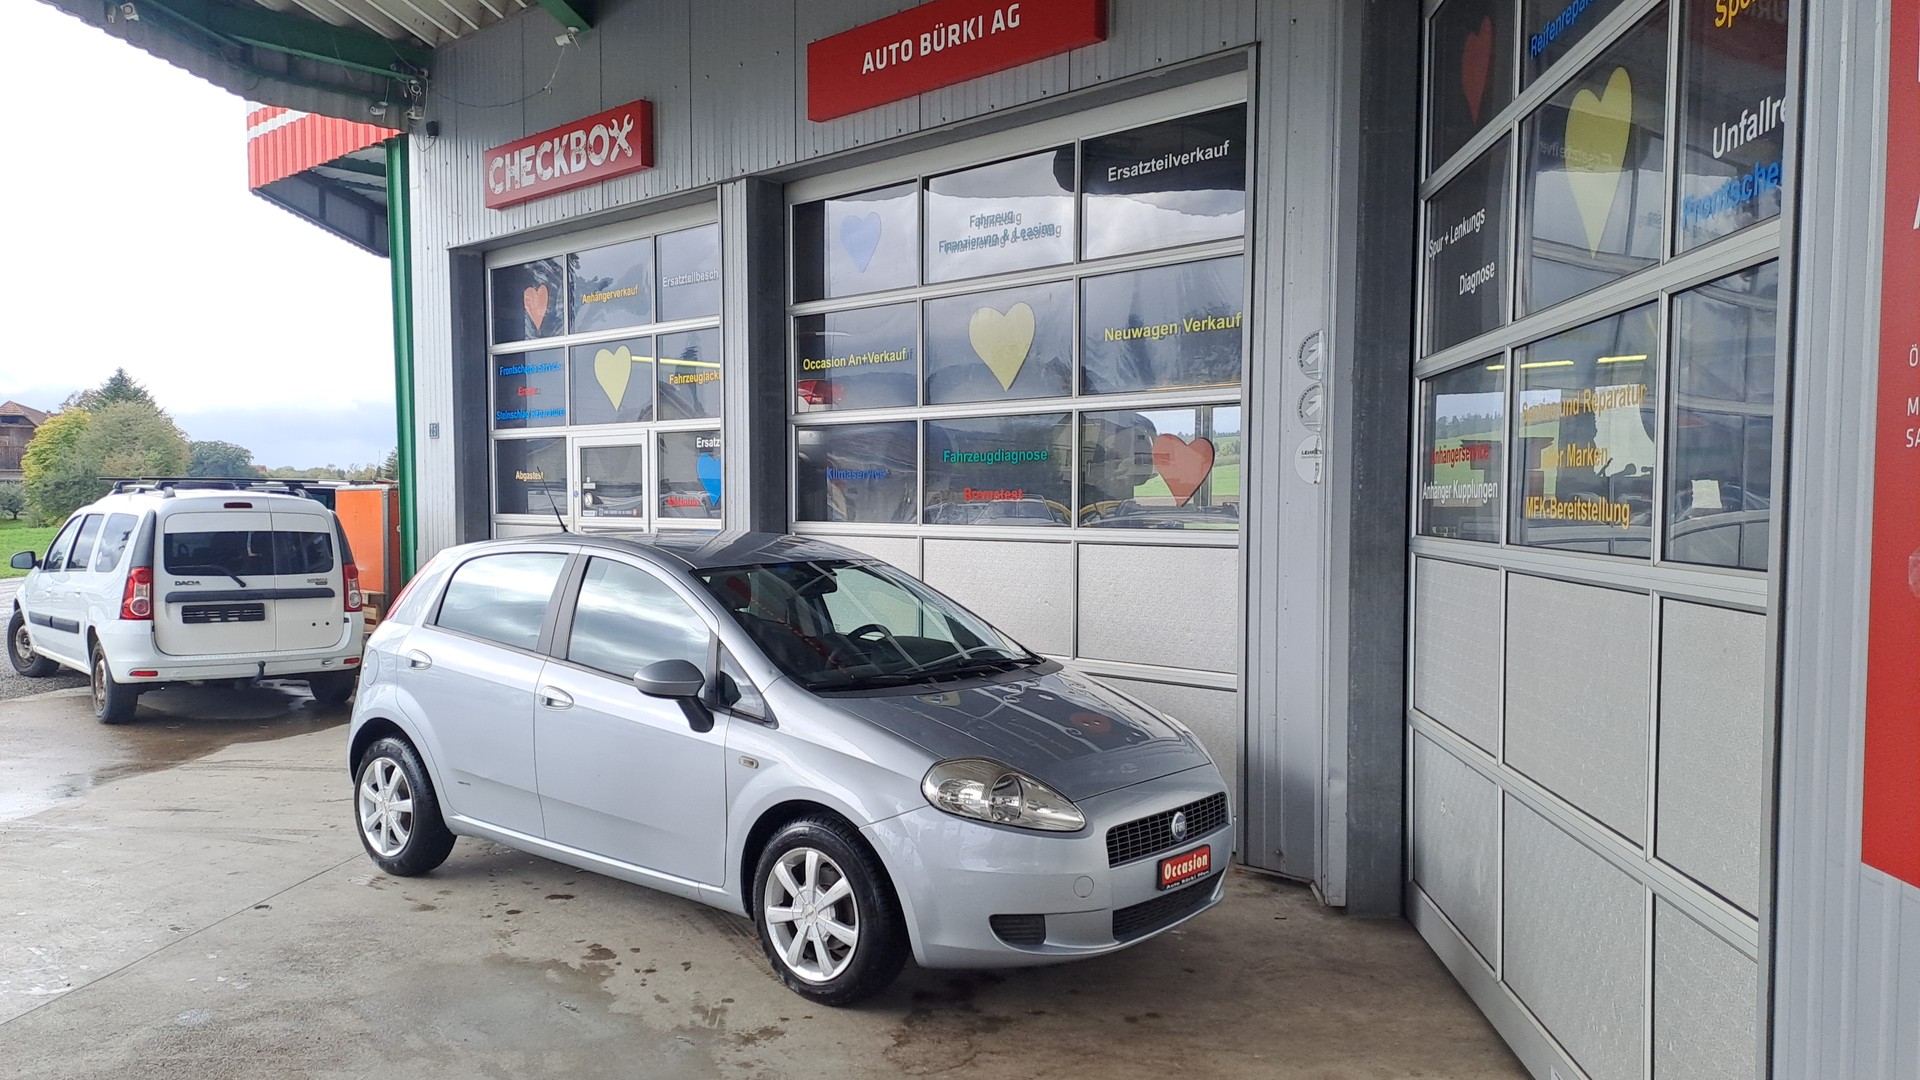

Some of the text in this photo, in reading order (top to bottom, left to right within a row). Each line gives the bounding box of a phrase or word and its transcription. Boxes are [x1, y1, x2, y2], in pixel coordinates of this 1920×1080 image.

[861, 3, 1020, 75] AUTO BÜRKI AG
[488, 113, 634, 195] CHECKBOX
[1108, 140, 1230, 182] Ersatzteilverkauf
[969, 211, 1016, 229] Fahrzeug
[938, 234, 1000, 254] Finanzierung
[1429, 208, 1486, 261] Spur + Lenkungs
[1459, 261, 1495, 296] Diagnose
[581, 284, 638, 304] Anhängerverkauf
[1104, 312, 1242, 341] Neuwagen Verkauf
[802, 347, 906, 370] Occasion An+Verkauf
[1561, 391, 1580, 417] und
[1583, 384, 1647, 417] Reparatur
[943, 449, 1048, 465] Fahrzeugdiagnose
[1566, 442, 1608, 467] Marken
[515, 470, 544, 482] Abgastest
[826, 467, 887, 480] Klimaservice
[963, 487, 1023, 501] Bremstest
[1422, 479, 1498, 504] Anhänger Kupplungen
[1525, 496, 1630, 530] MFK-Bereitstellung
[1164, 853, 1208, 880] Occasion
